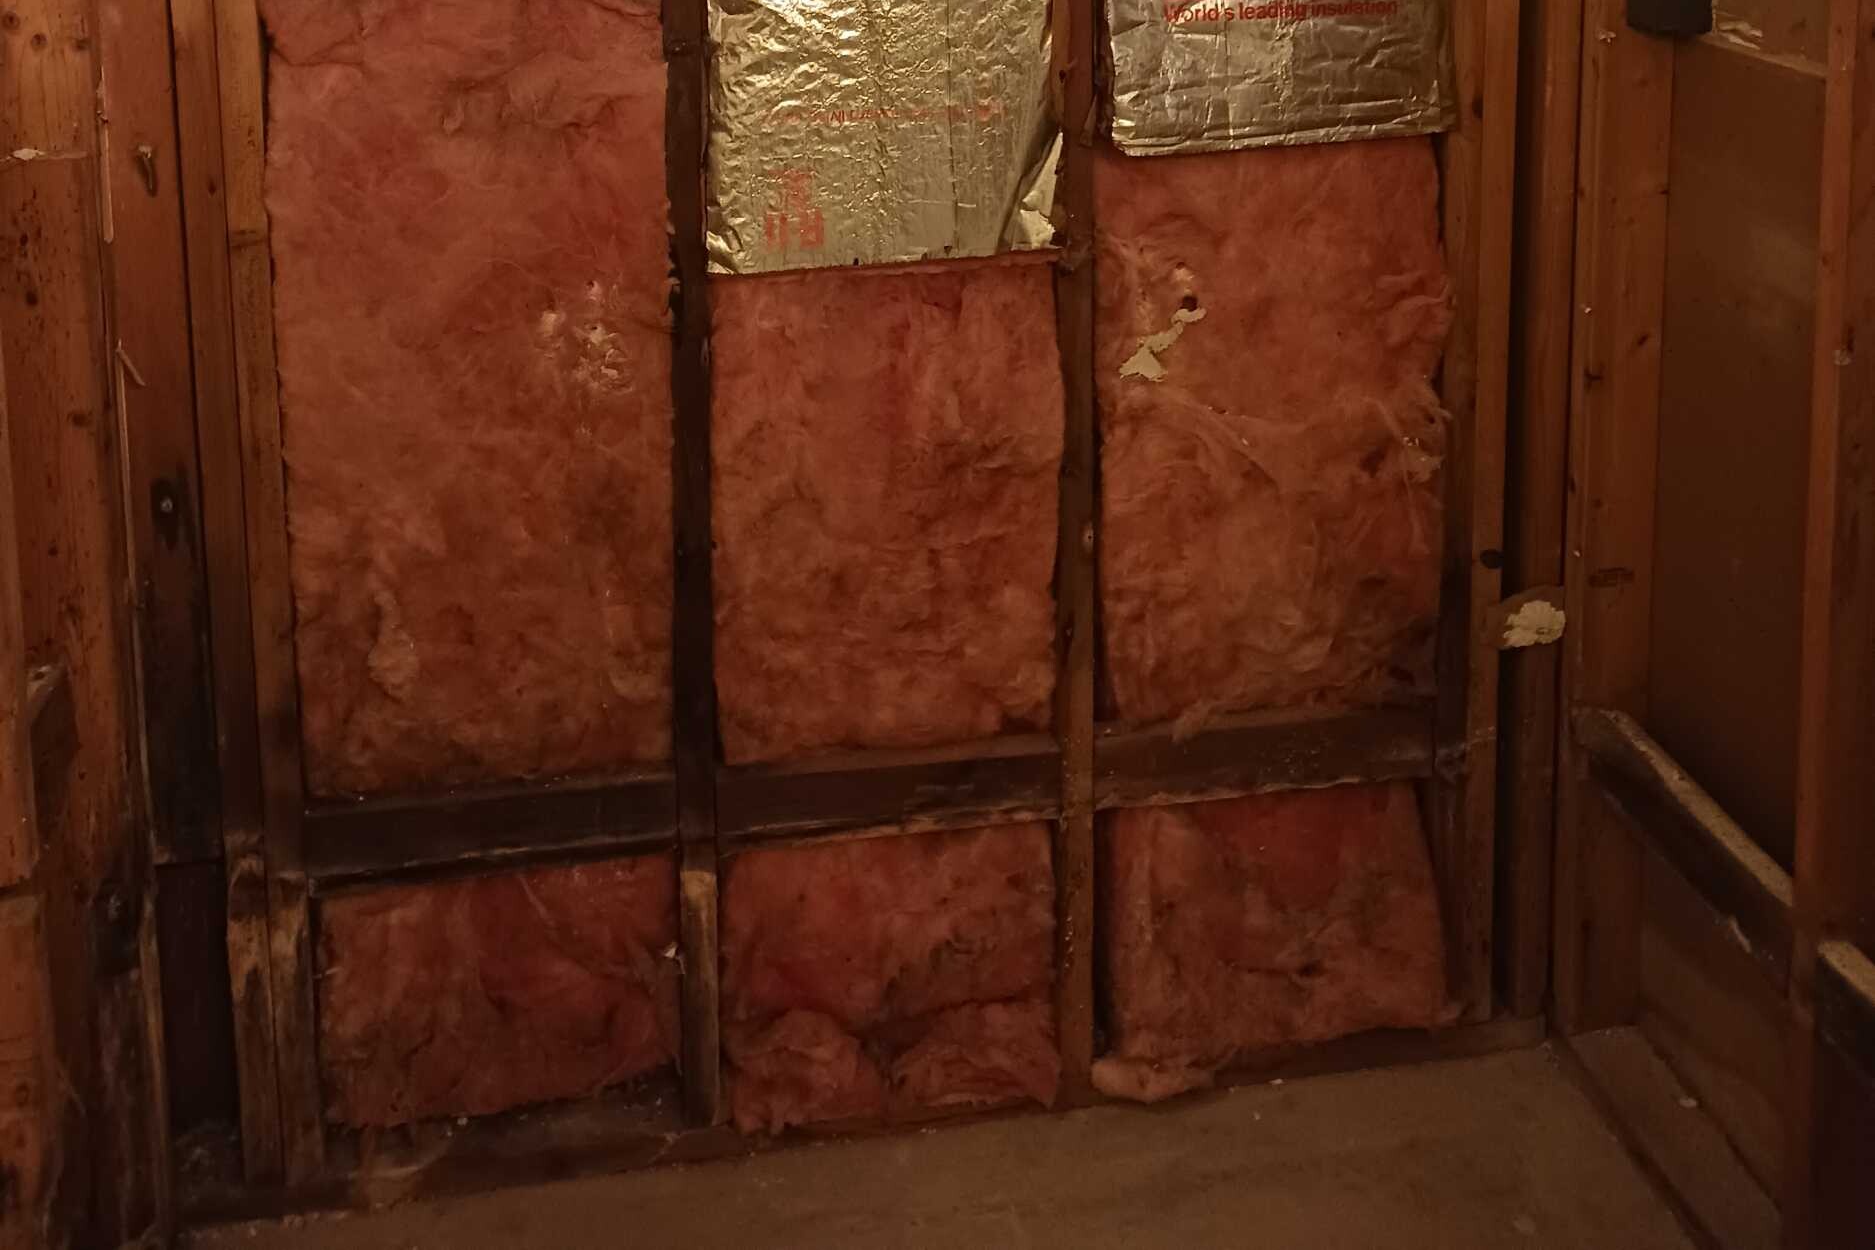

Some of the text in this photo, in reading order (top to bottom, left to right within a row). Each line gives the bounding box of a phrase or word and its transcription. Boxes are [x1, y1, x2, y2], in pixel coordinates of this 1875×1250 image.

[1164, 0, 1398, 23] World's leading insulation
